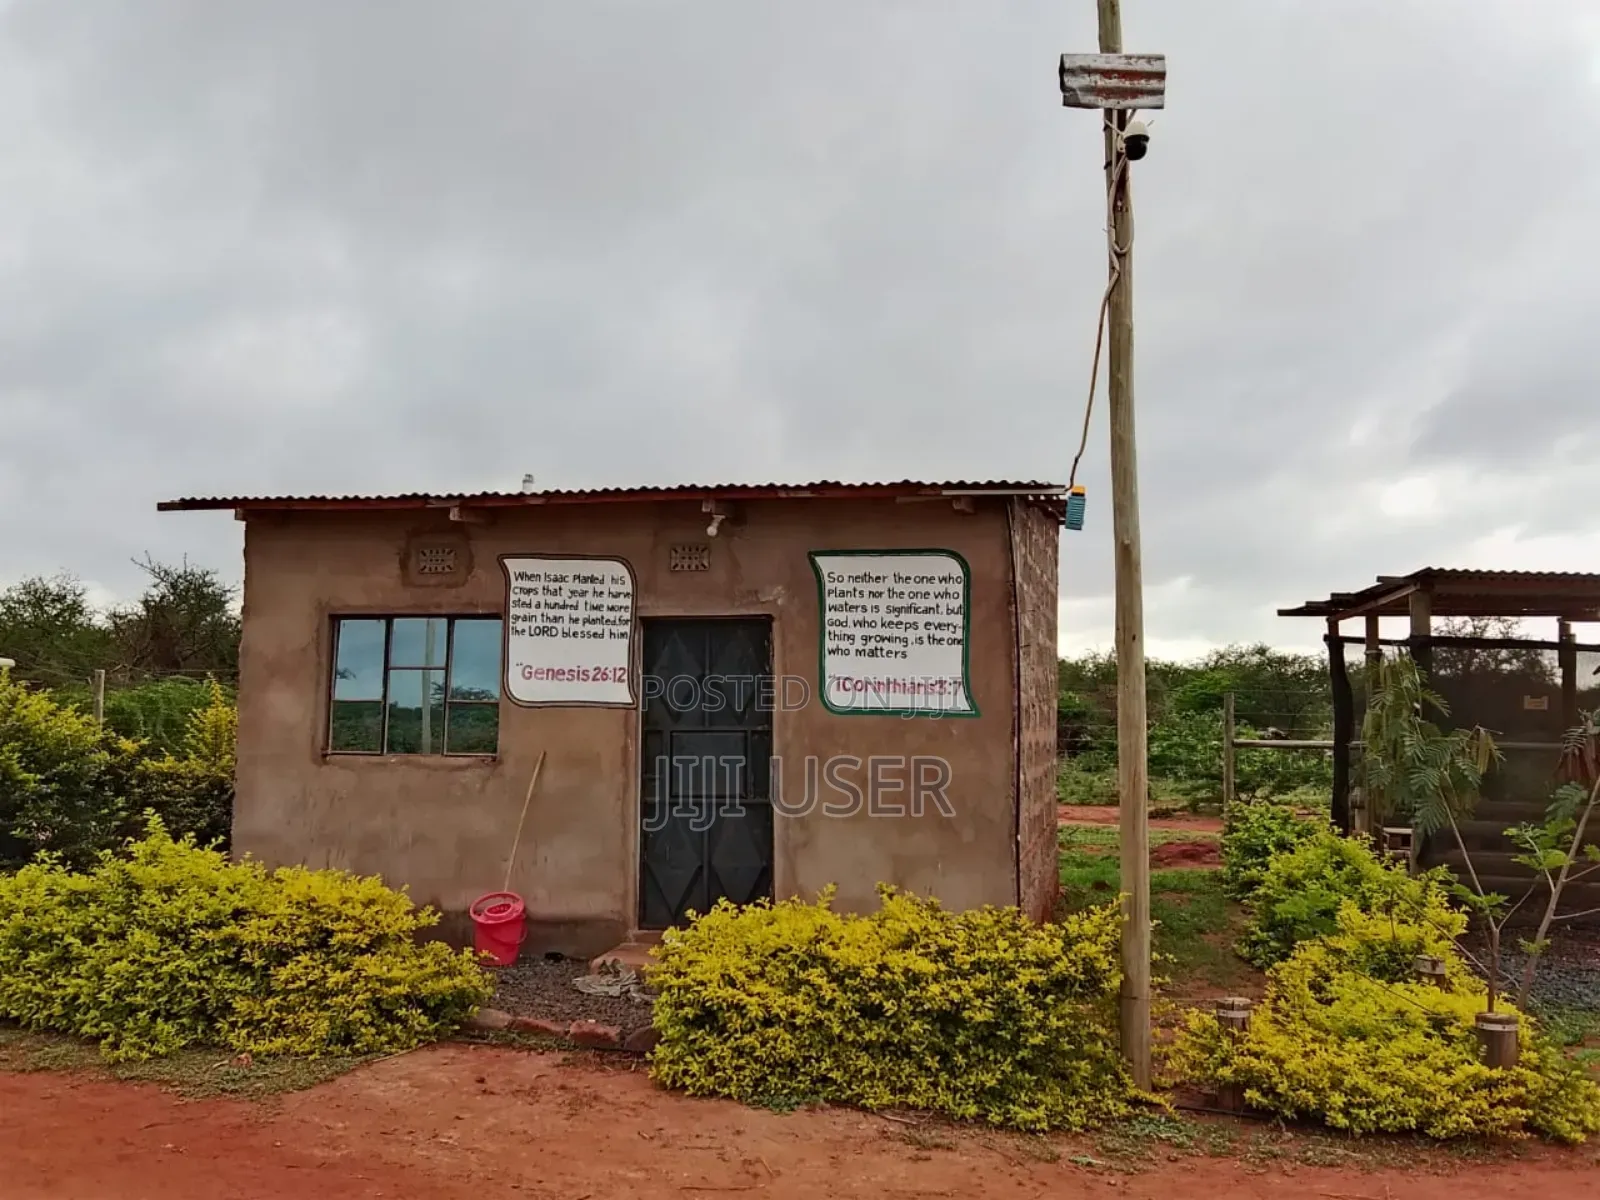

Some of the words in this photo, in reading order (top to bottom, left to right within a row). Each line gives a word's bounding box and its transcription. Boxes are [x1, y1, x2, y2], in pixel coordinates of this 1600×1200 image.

[514, 571, 541, 582] When
[544, 571, 569, 583] Isaac
[611, 575, 625, 585] his
[827, 571, 844, 583] So
[848, 571, 888, 584] neither
[893, 571, 911, 584] the
[913, 575, 935, 584] one
[938, 572, 962, 584] who
[543, 585, 563, 597] that
[568, 589, 589, 599] year
[593, 586, 604, 598] he
[868, 590, 884, 599] nor
[888, 587, 905, 599] the
[908, 590, 930, 600] one
[933, 587, 960, 600] who
[535, 600, 541, 609] a
[544, 599, 579, 611] hundred
[828, 601, 868, 613] waters
[870, 605, 880, 613] is
[511, 613, 536, 624] grain
[541, 612, 564, 624] than
[569, 613, 580, 624] he
[853, 616, 877, 628] who
[881, 616, 919, 632] keeps
[529, 625, 559, 637] LORD
[562, 627, 605, 639] blessed
[610, 628, 628, 640] him
[828, 630, 855, 646] thing
[927, 633, 945, 646] the
[946, 637, 964, 646] one
[828, 644, 850, 656] who
[855, 646, 907, 659] matters
